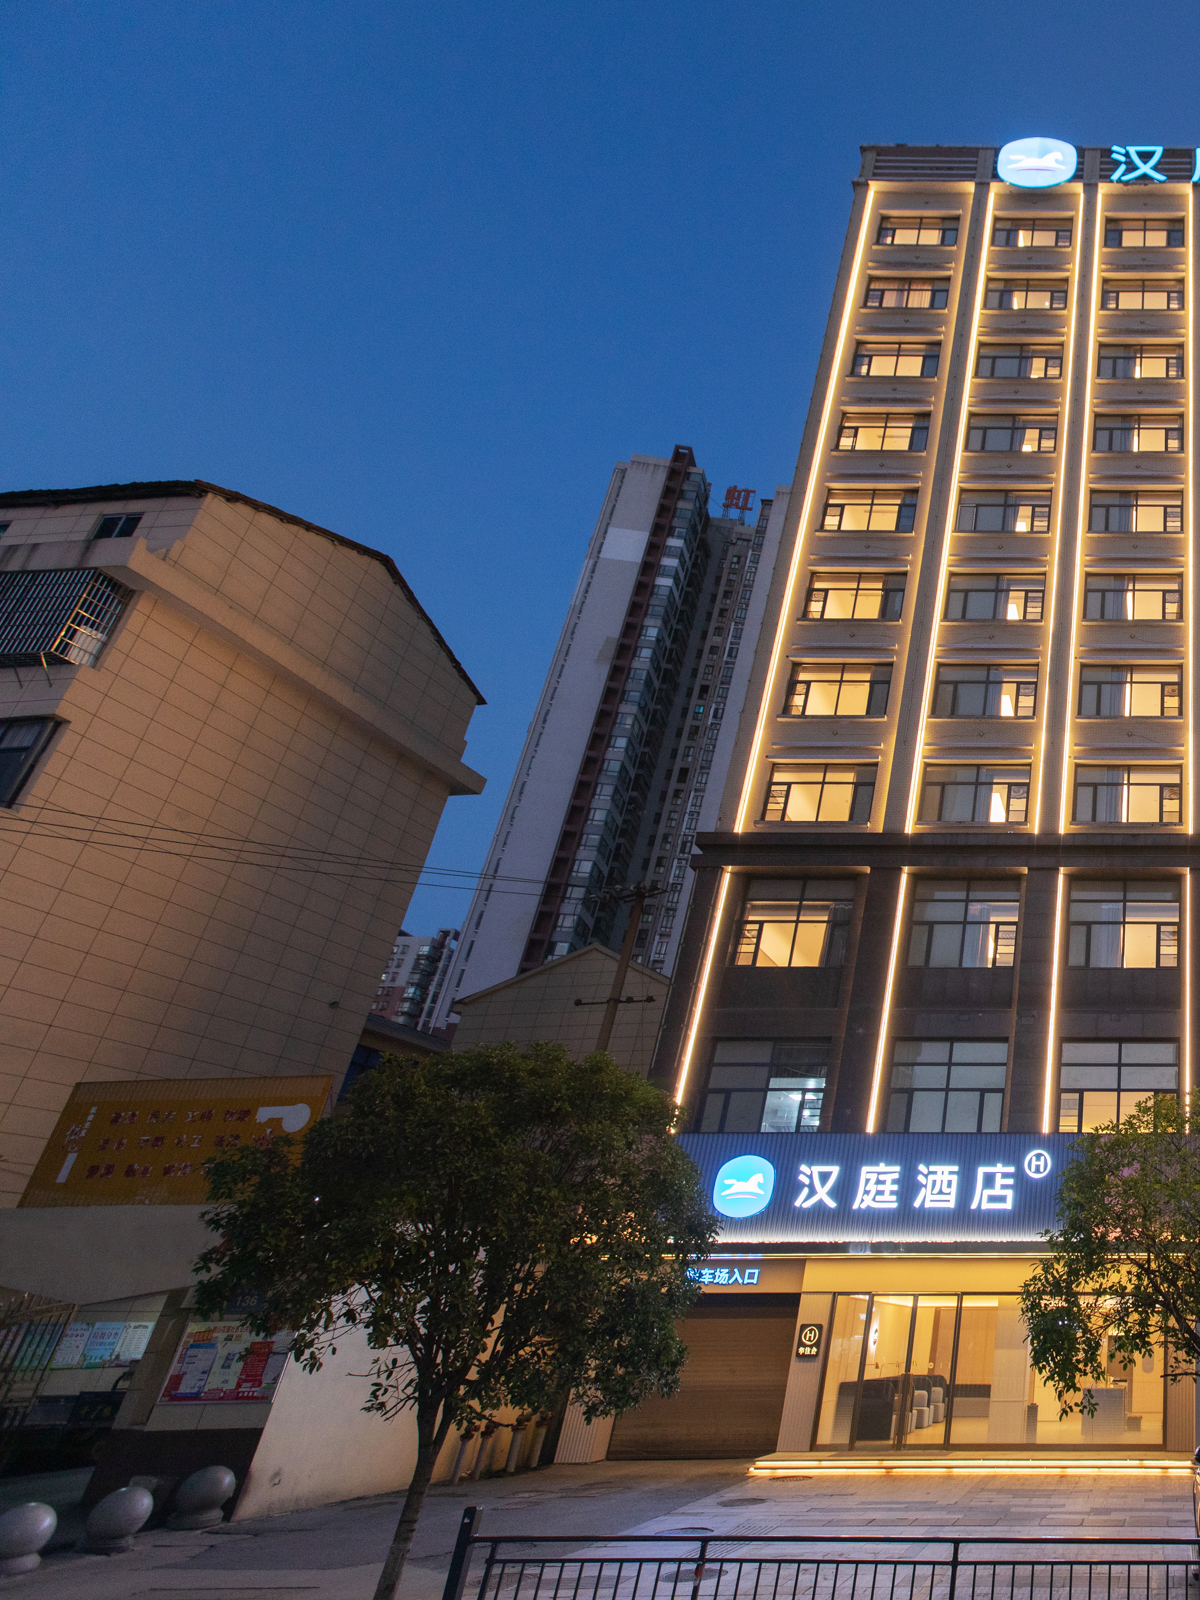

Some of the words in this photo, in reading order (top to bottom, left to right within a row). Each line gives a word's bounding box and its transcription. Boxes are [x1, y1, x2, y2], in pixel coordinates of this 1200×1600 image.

[794, 1162, 1016, 1210] 汉庭酒店
[236, 1295, 258, 1307] 136
